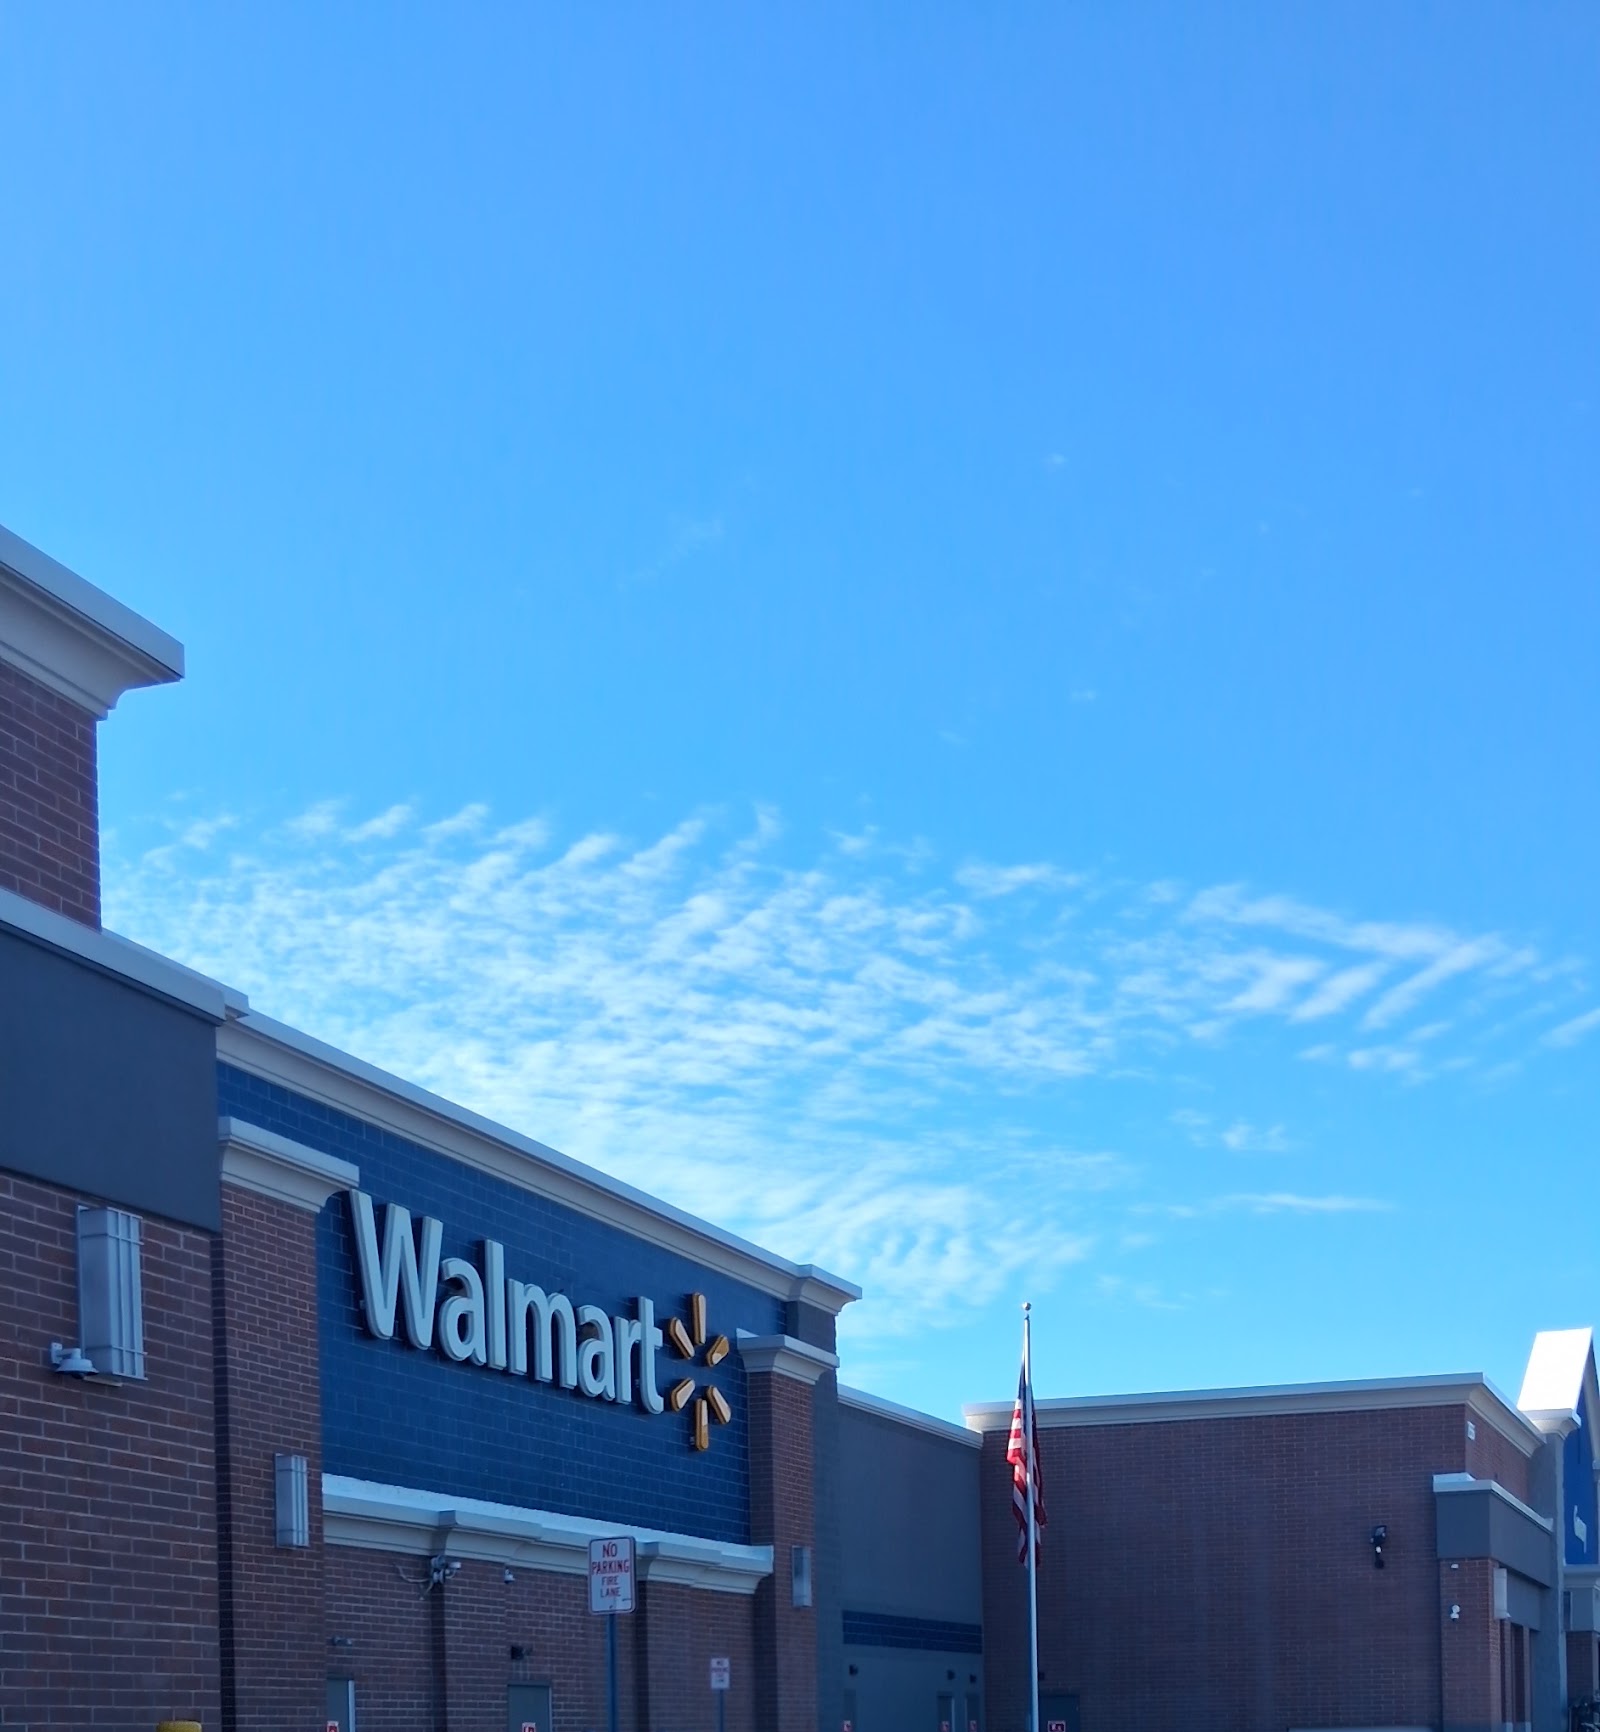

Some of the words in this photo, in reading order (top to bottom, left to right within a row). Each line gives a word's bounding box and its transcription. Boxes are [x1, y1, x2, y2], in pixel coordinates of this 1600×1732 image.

[350, 1188, 664, 1414] Walmart
[602, 1542, 618, 1558] NO
[591, 1559, 629, 1575] PARKING
[602, 1576, 619, 1586] FIRE
[600, 1587, 621, 1598] LANE
